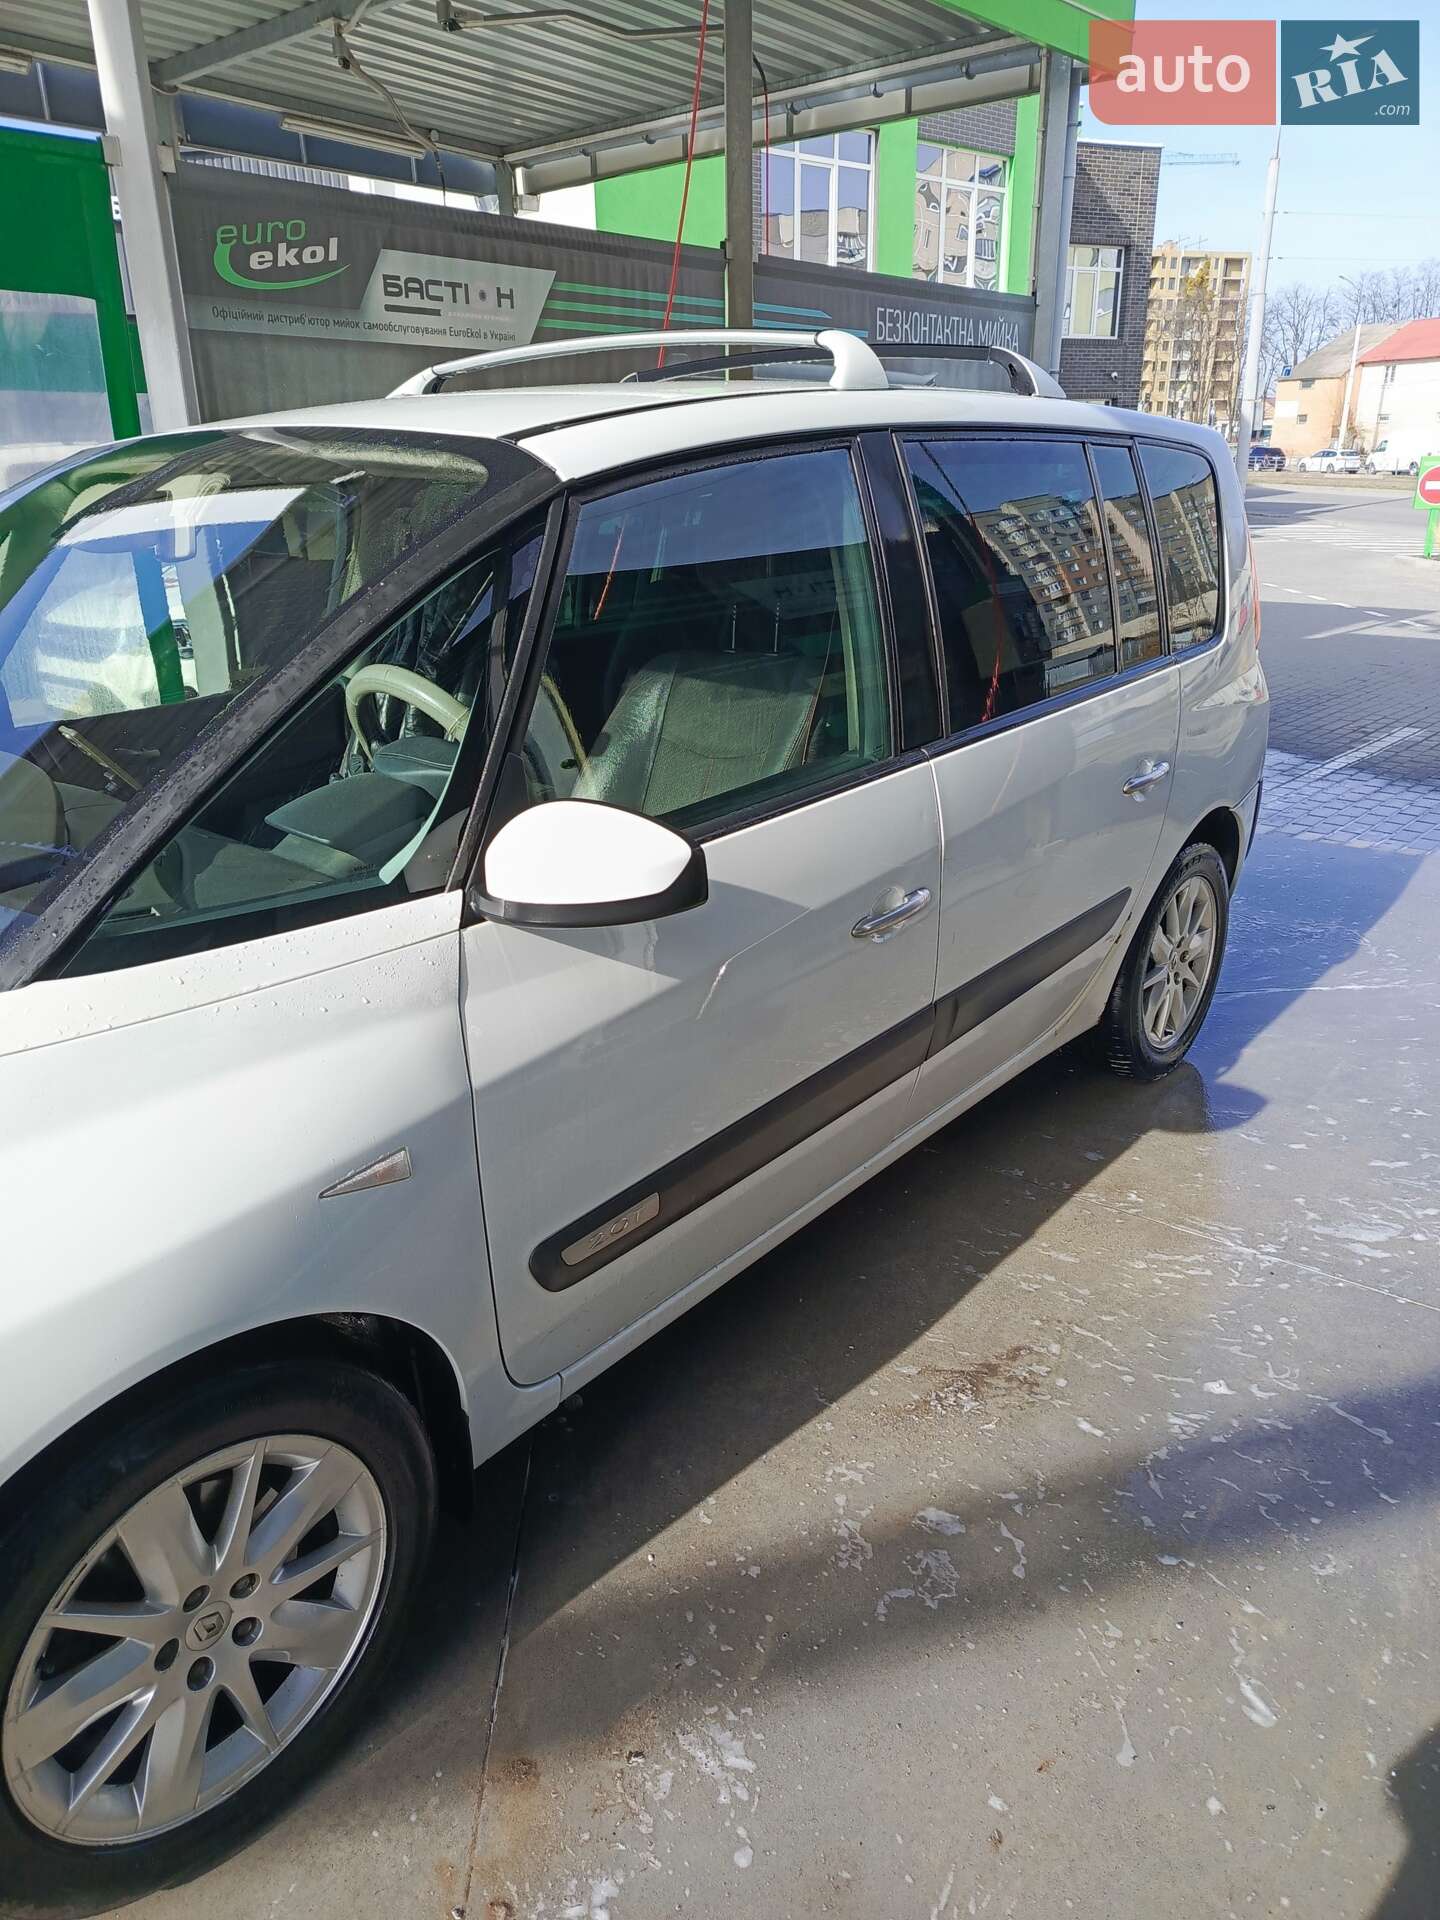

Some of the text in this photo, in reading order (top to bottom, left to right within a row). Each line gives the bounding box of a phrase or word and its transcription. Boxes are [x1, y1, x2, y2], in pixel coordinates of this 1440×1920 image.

[216, 219, 307, 245] euro
[249, 237, 338, 270] ekol
[382, 273, 514, 309] БАСТІН
[211, 305, 264, 320] Офіційний
[333, 319, 360, 329] мийок
[362, 320, 447, 336] самообслуговування
[448, 326, 481, 339] EuroEkol
[489, 330, 516, 342] Україні
[876, 307, 1019, 352] БЕЗКОНТАКТНА МИЙКА
